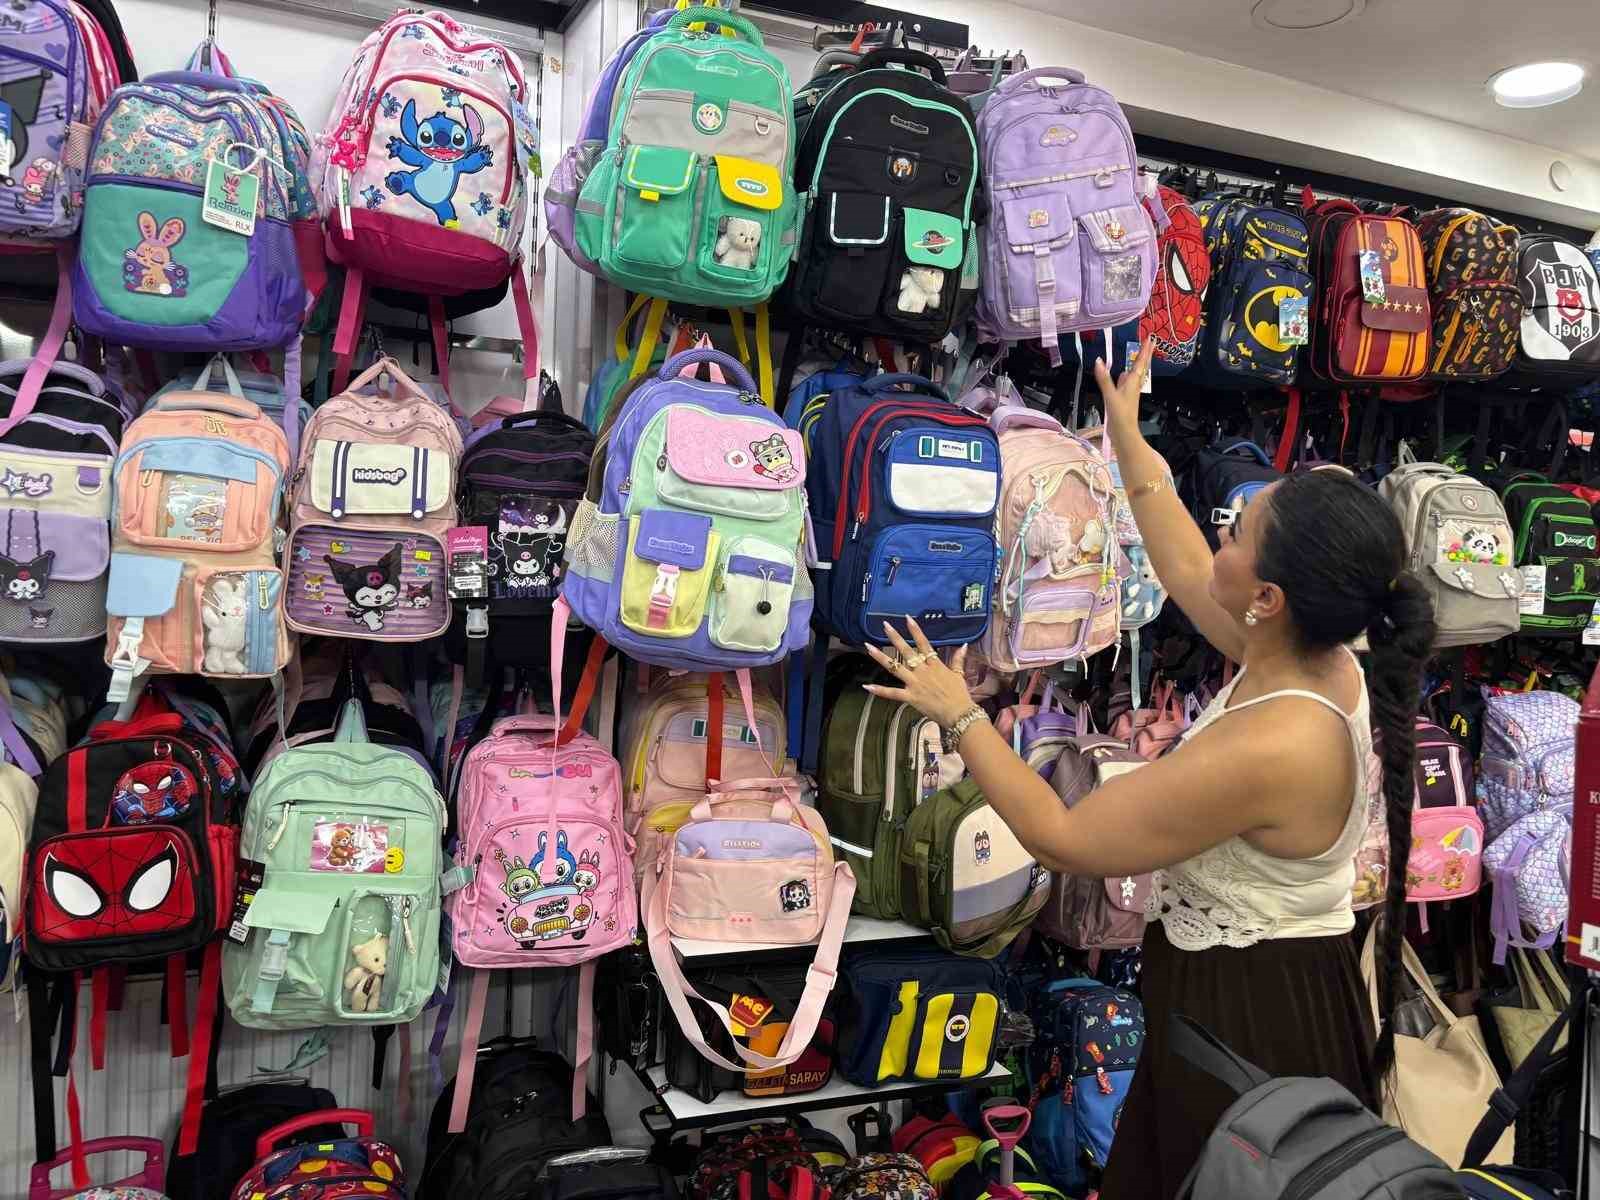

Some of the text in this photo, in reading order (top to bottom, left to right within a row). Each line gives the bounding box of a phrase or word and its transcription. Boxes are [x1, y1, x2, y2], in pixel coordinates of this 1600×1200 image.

[1543, 267, 1587, 288] BJK
[1555, 324, 1590, 339] 1903
[789, 1071, 826, 1086] SARAY
